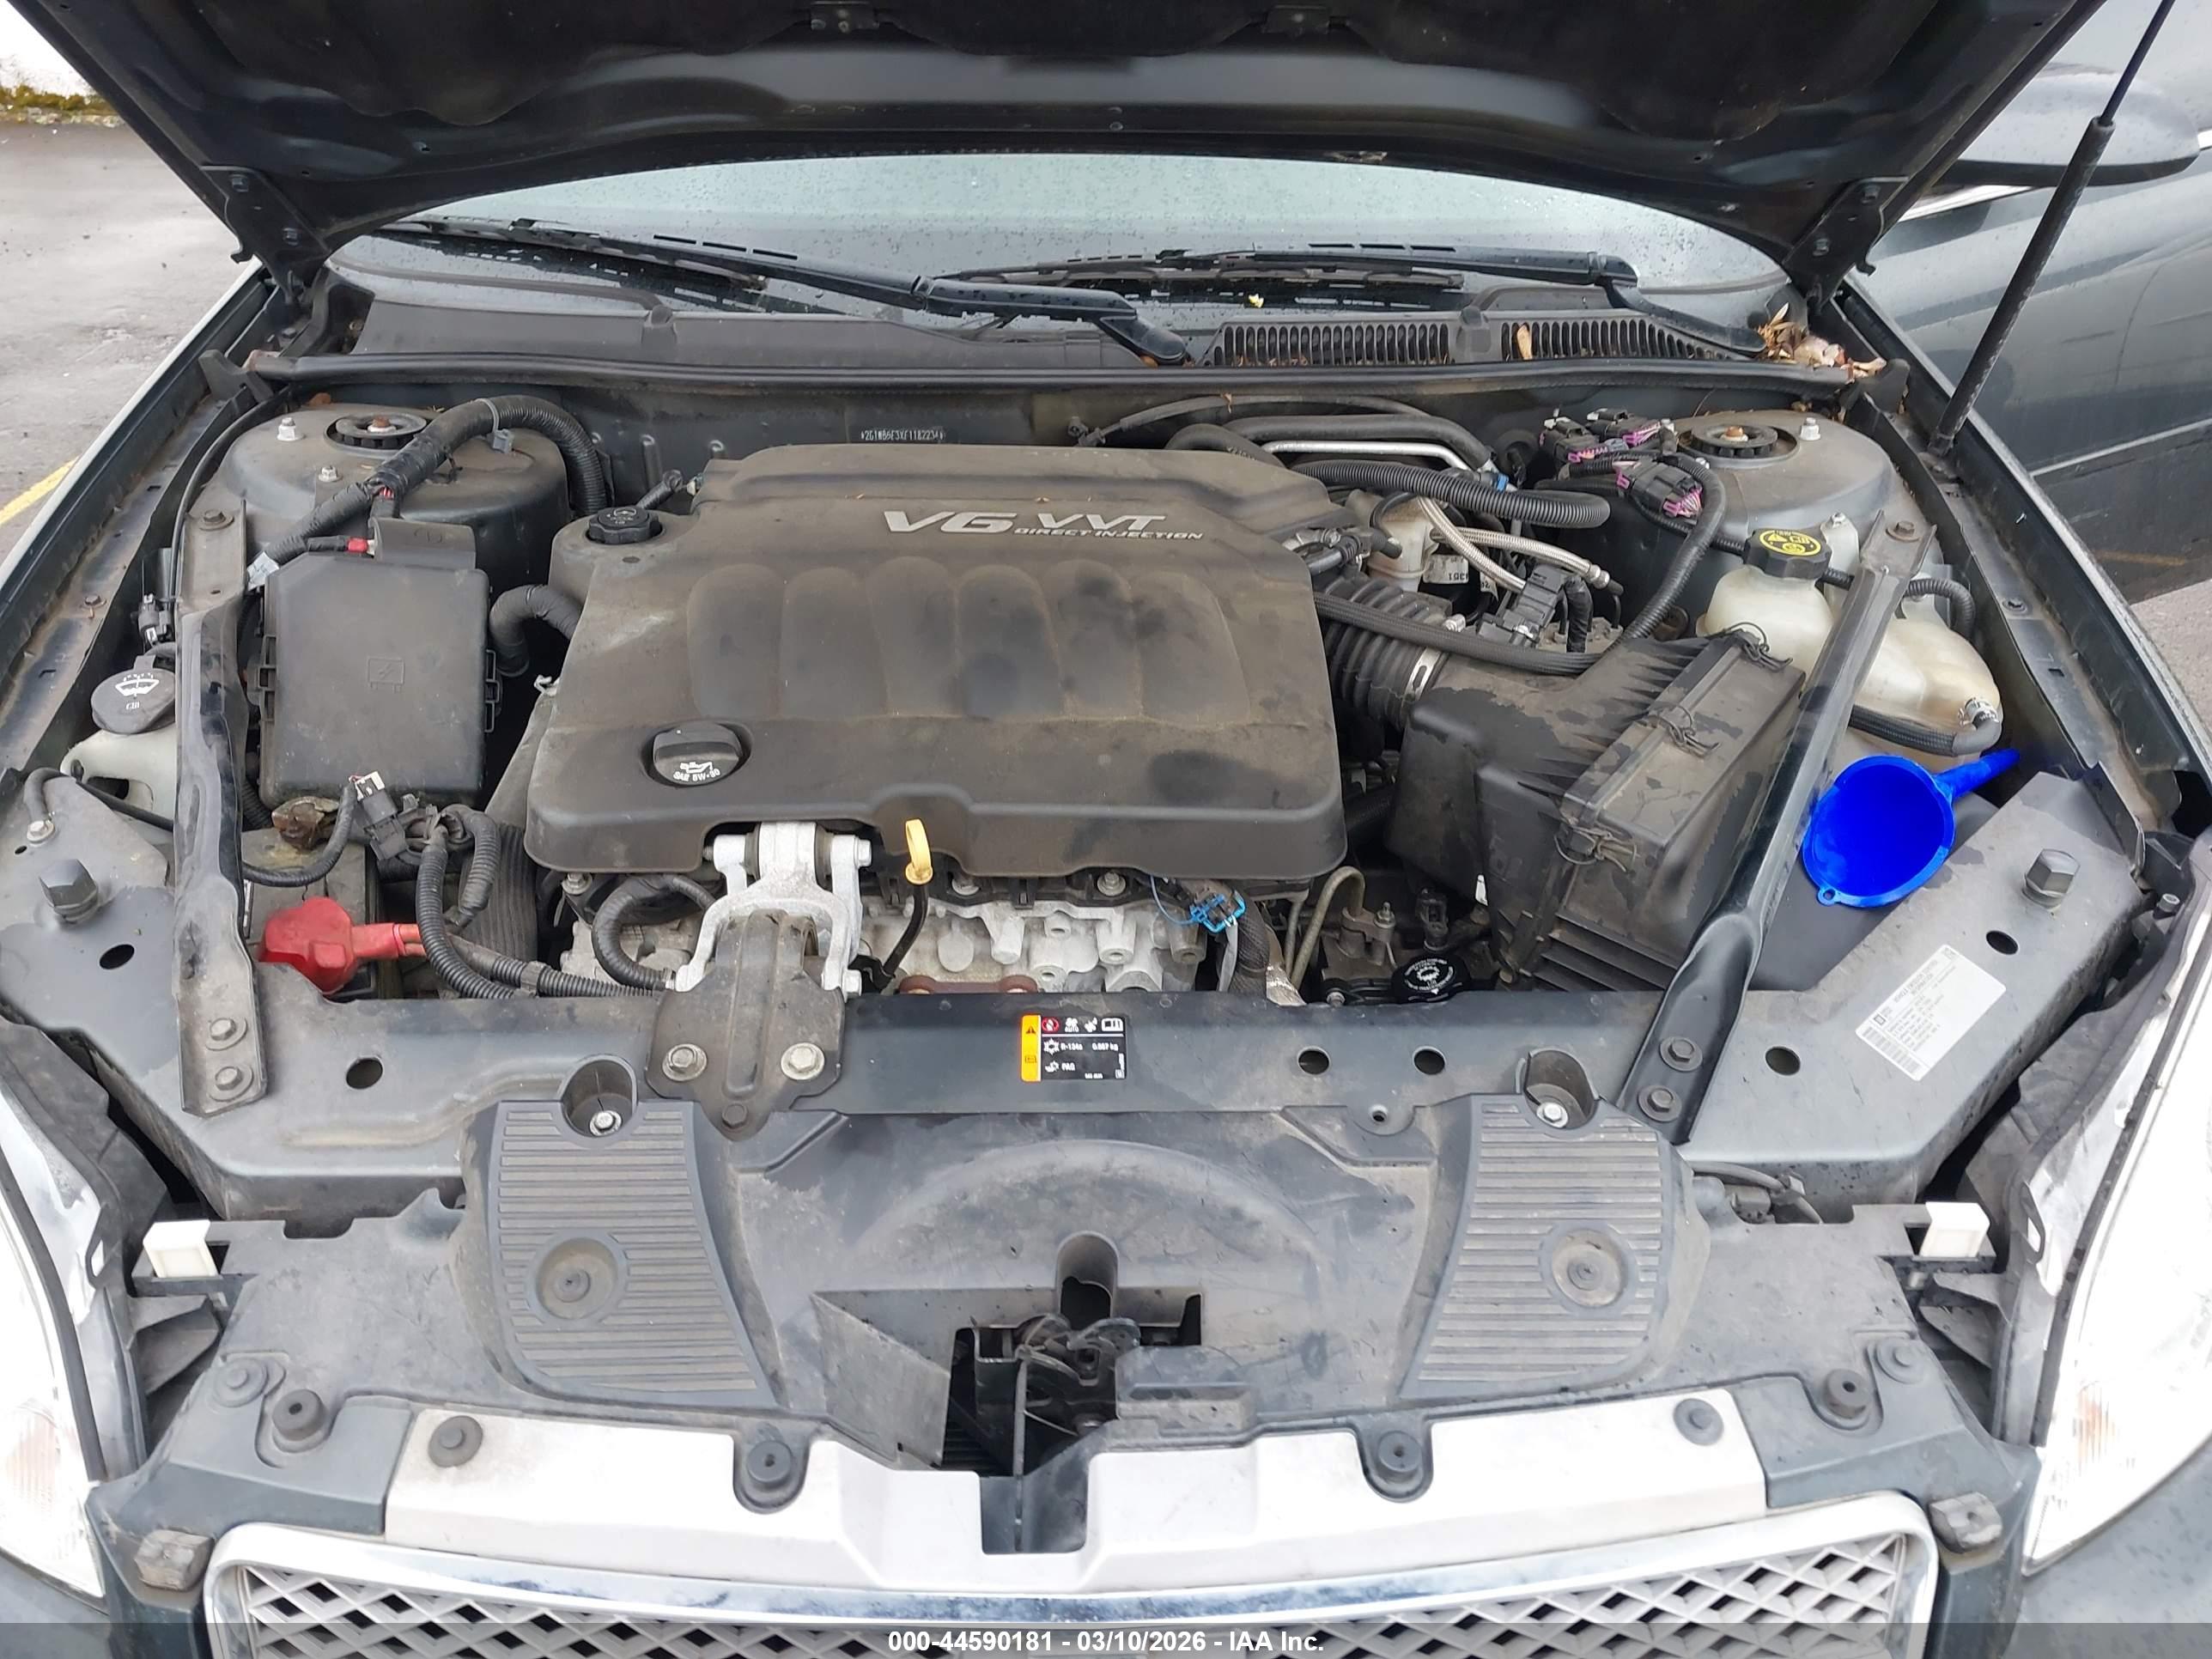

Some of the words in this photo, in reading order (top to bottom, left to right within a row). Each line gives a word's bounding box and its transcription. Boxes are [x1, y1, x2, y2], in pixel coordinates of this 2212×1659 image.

[884, 511, 1017, 533] V6
[1037, 514, 1166, 530] VVT
[1094, 530, 1204, 539] INJECTION
